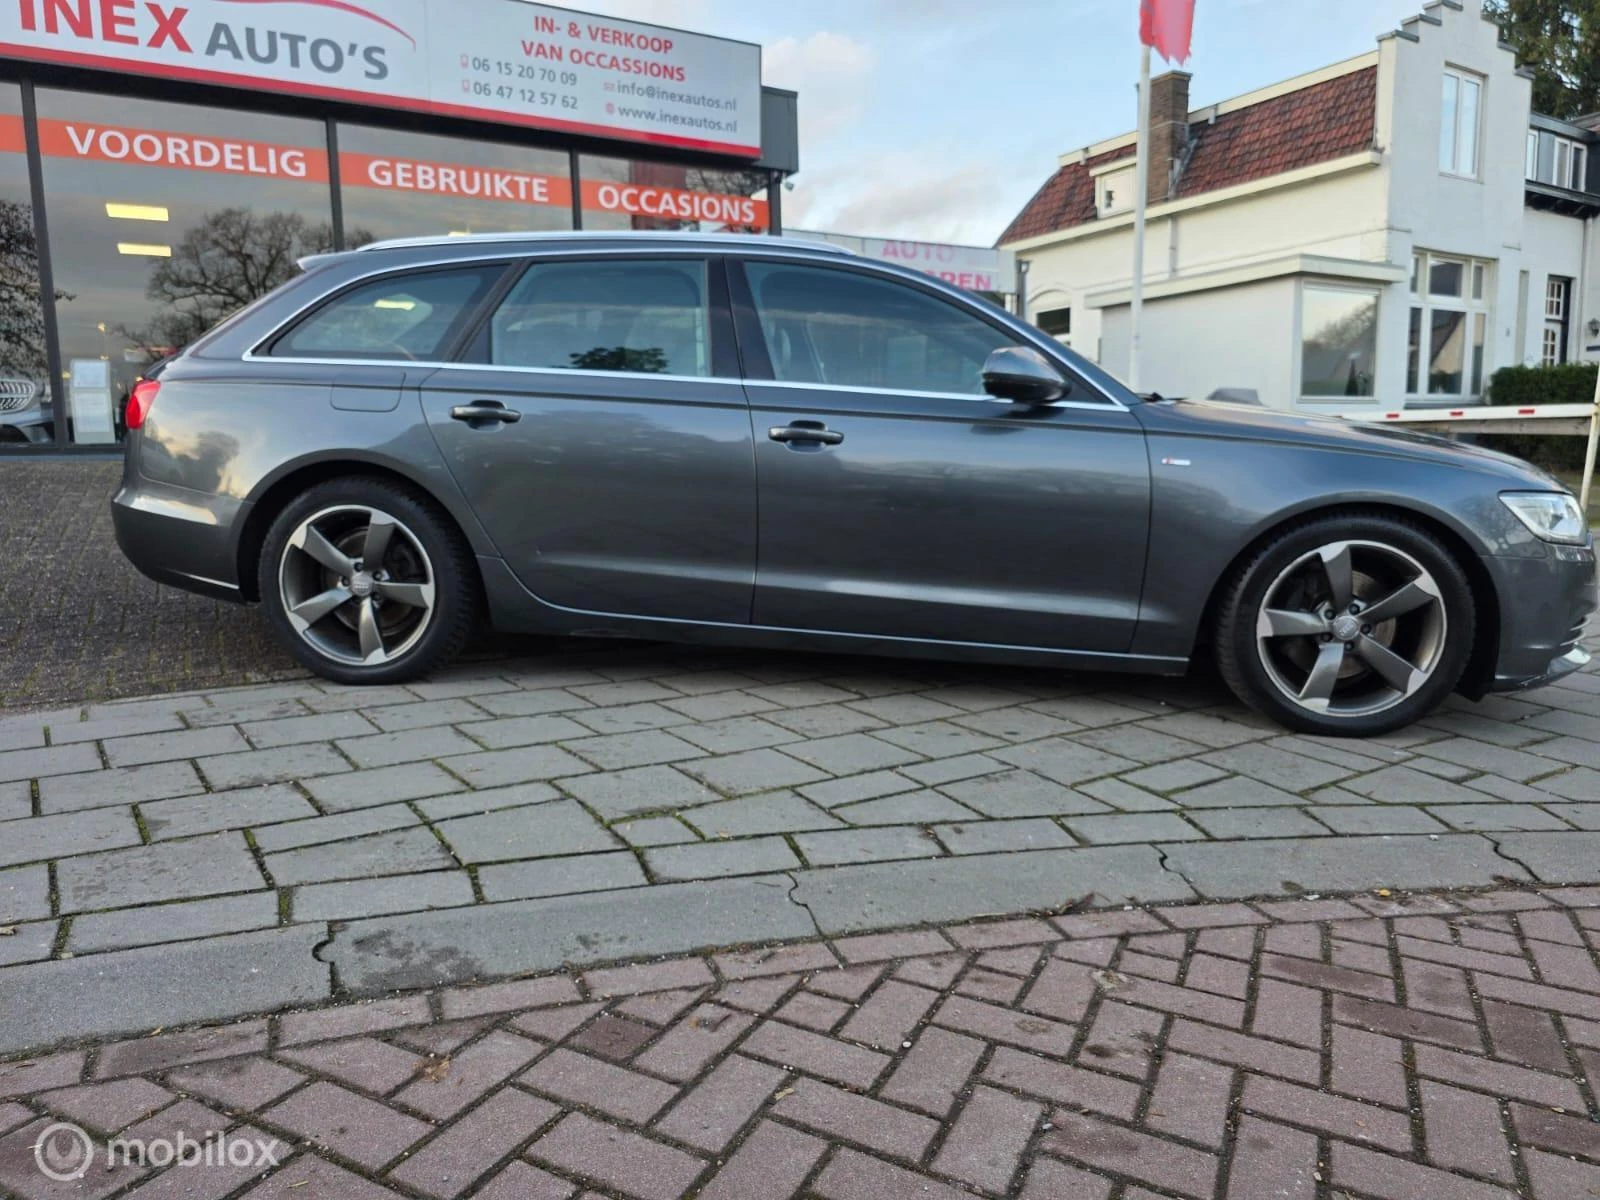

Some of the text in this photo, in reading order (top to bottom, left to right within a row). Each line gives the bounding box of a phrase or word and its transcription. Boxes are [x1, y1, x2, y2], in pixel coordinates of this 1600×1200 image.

[20, 0, 389, 80] INEX AUTO'S
[534, 15, 673, 54] IN- & VERKOOP
[472, 57, 577, 86] 06 15 20 70 09
[521, 40, 685, 82] VAN OCCASSIONS
[473, 81, 578, 109] 06 47 12 57 62
[617, 80, 737, 111] info@inexautos.nl
[617, 105, 737, 133] www.inexautos.nl
[66, 125, 306, 177] VOORDELIG
[367, 160, 549, 202] GEBRUIKTE
[597, 184, 756, 223] OCCASIONS
